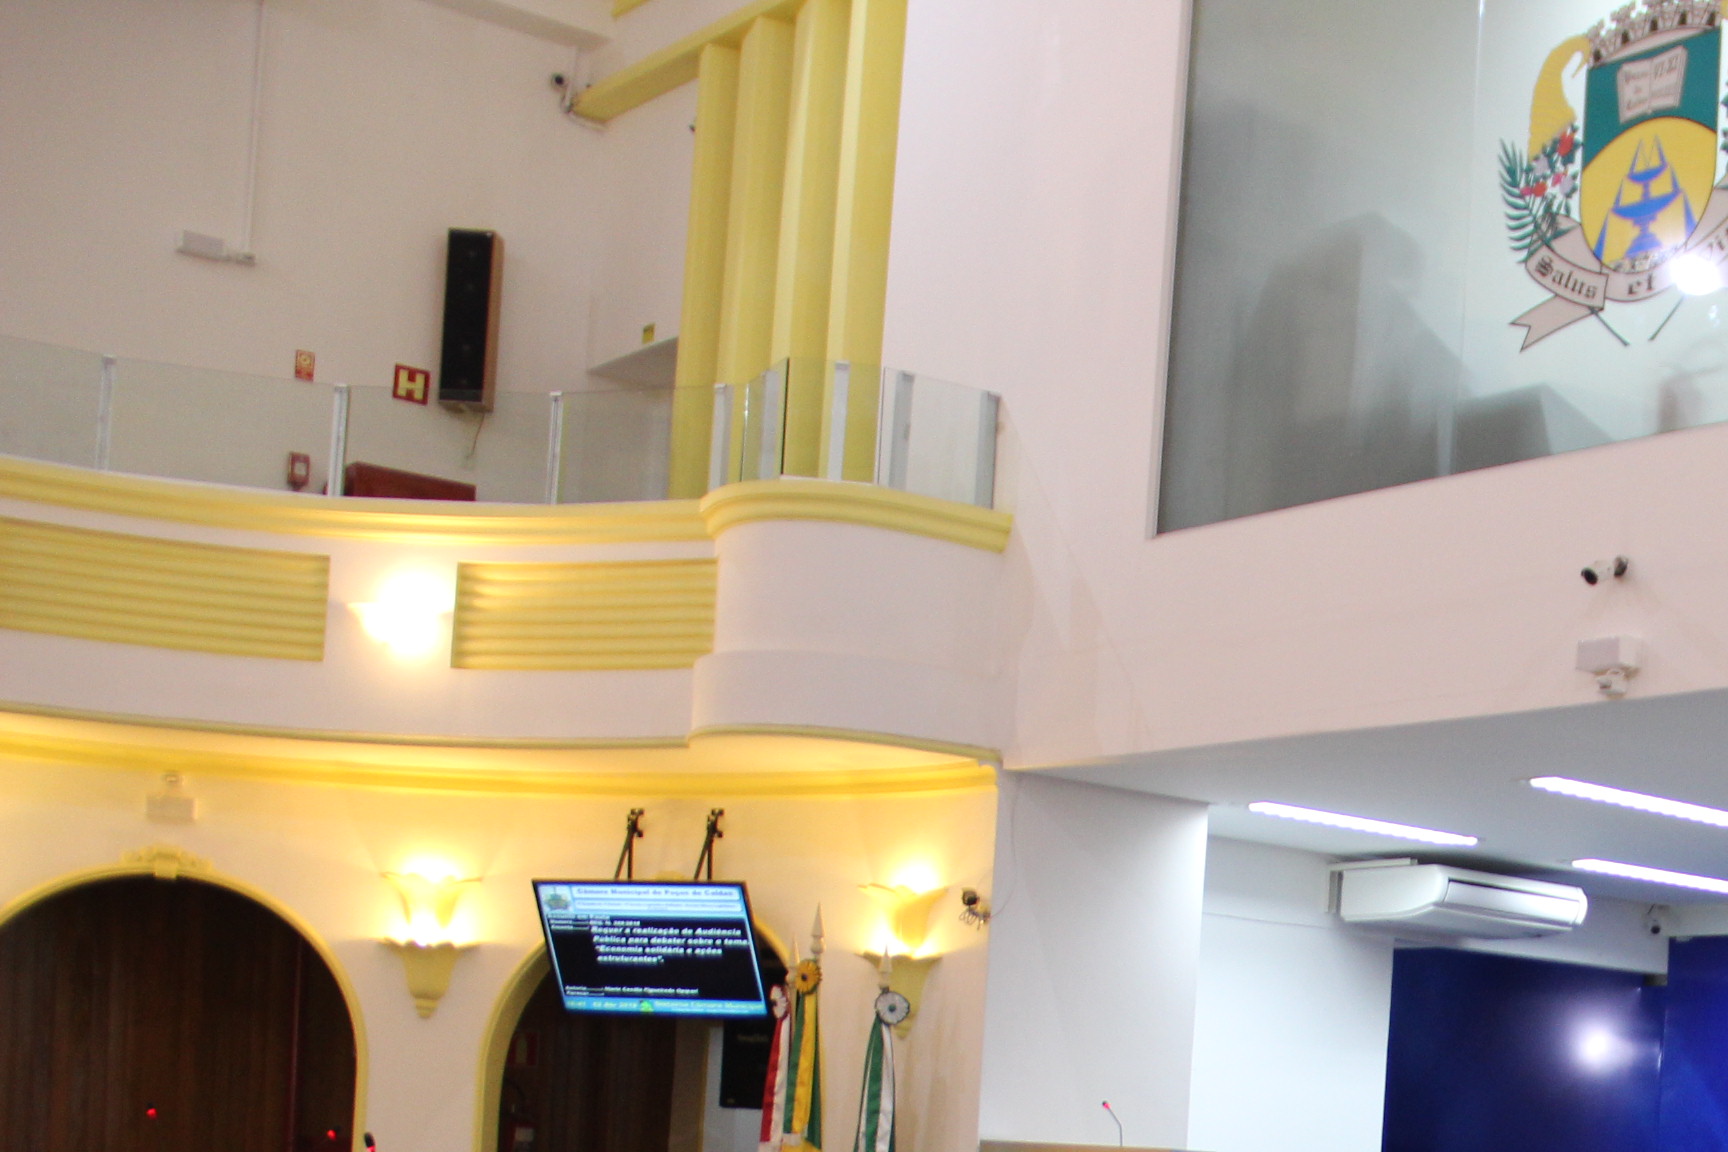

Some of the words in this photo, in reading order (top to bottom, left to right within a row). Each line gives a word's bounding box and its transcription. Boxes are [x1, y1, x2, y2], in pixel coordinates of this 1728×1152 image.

[1534, 254, 1599, 300] Salus
[590, 925, 624, 935] Requer
[632, 926, 680, 936] realização
[681, 927, 694, 936] de
[694, 927, 742, 937] Audiência
[593, 934, 627, 943] Pública
[627, 937, 649, 945] para
[650, 936, 687, 945] debater
[687, 937, 714, 946] sobre
